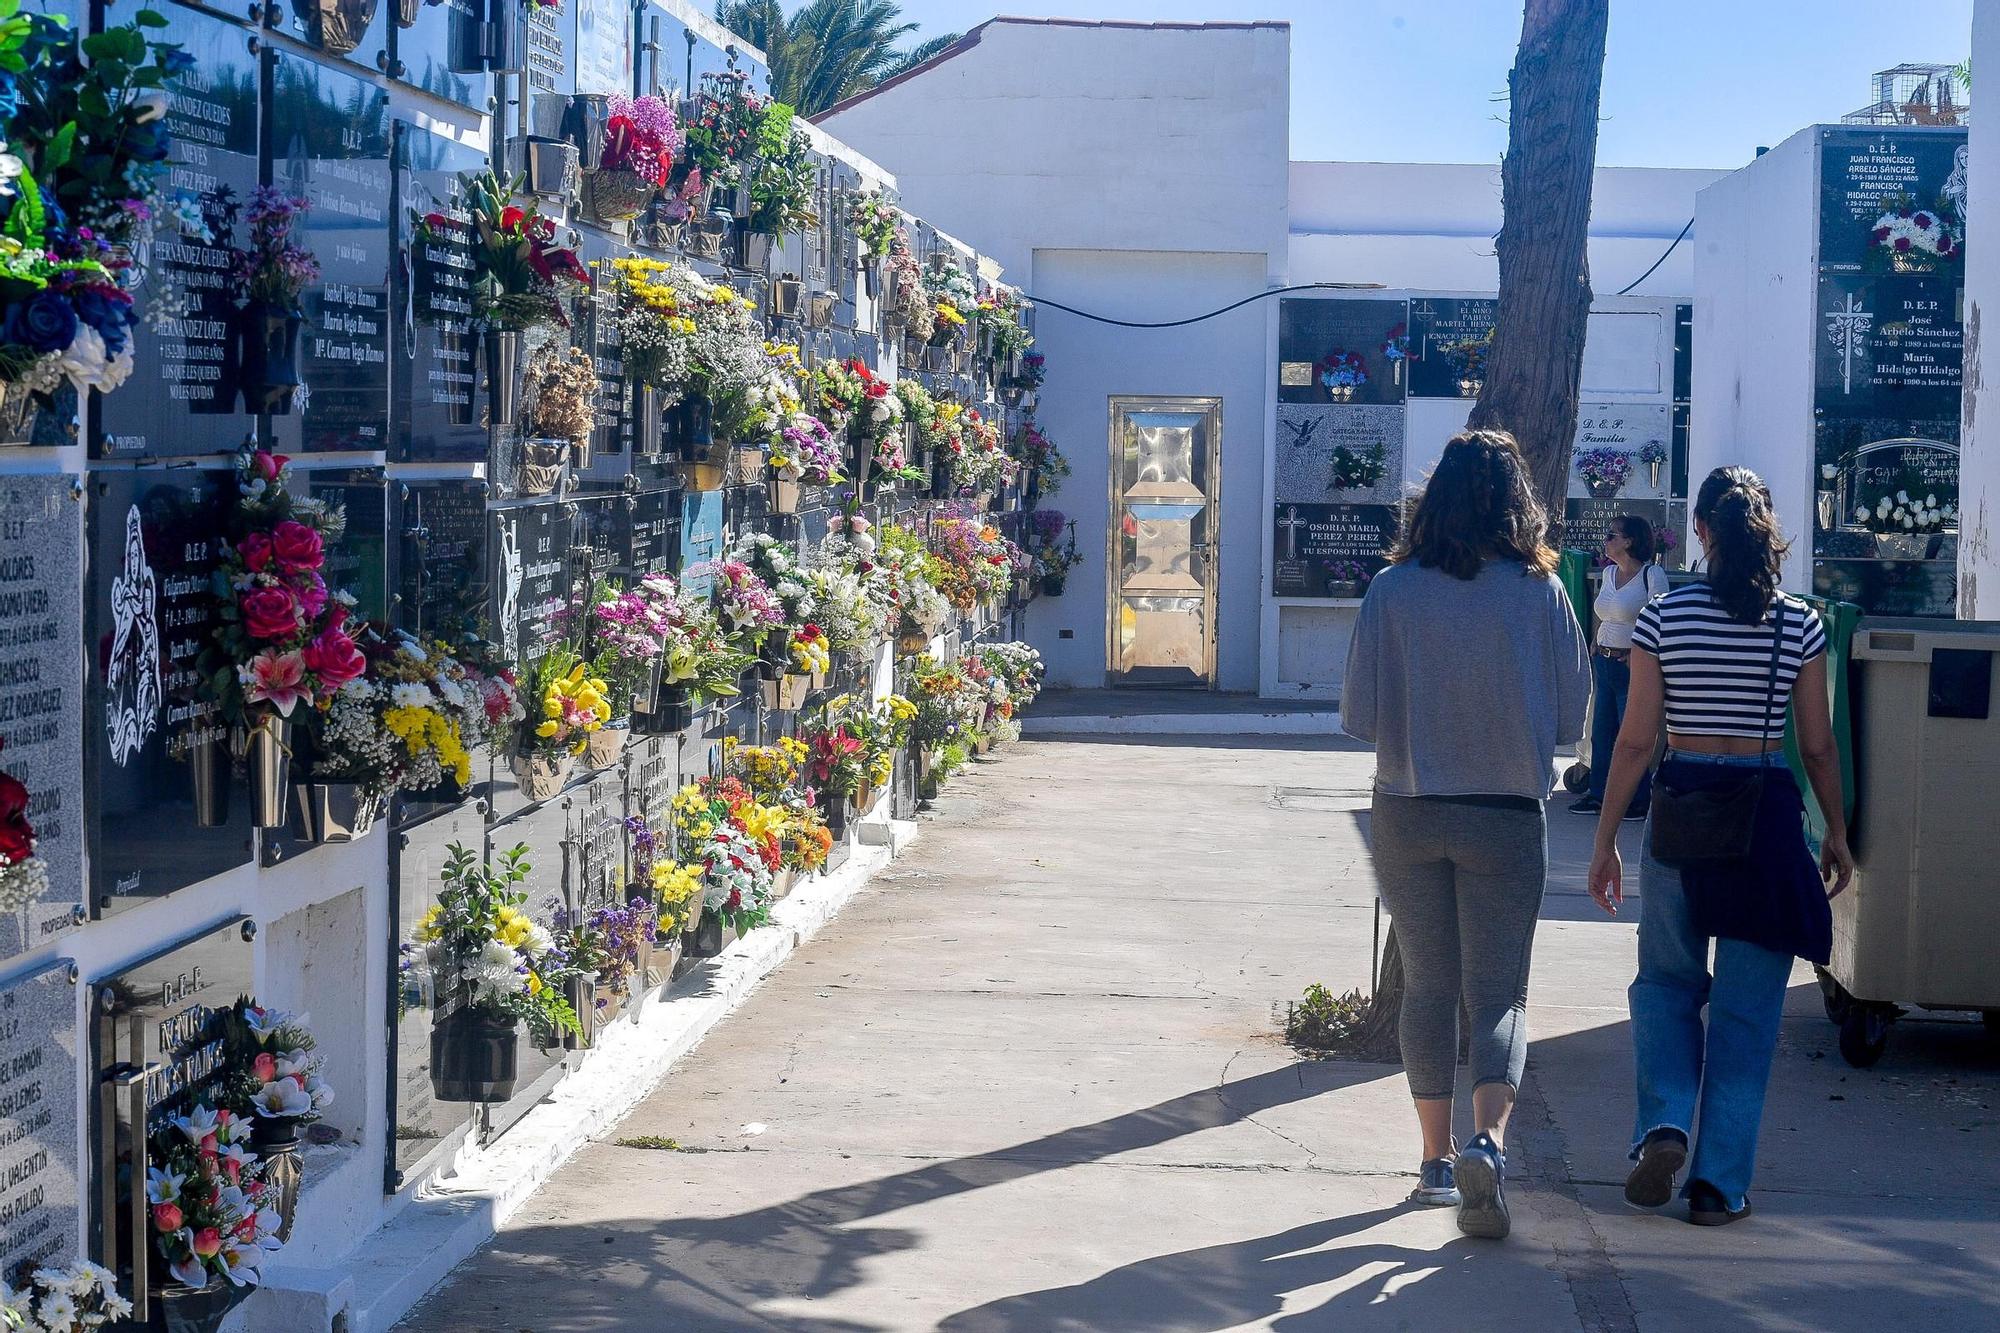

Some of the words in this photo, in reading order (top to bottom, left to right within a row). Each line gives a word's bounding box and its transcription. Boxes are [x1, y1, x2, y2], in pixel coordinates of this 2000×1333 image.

[1850, 155, 1869, 163] JUAN
[1871, 156, 1915, 164] FRANCISCO
[1849, 165, 1879, 173] ARBELO
[1880, 164, 1916, 174] SÁNCHEZ
[1860, 182, 1903, 190] FRANCISCA
[201, 247, 230, 269] GUEDES
[323, 282, 343, 304] Isabel
[343, 285, 358, 309] Vega
[357, 287, 377, 308] Ramos
[343, 312, 357, 337] Vega
[357, 315, 377, 335] Ramos
[1436, 320, 1468, 328] MARTEL
[1908, 315, 1932, 324] José
[1880, 327, 1914, 336] Arbelo
[1917, 327, 1960, 337] Sánchez
[326, 339, 351, 361] Carmen
[351, 342, 365, 365] Vega
[364, 343, 385, 363] Ramos
[1904, 353, 1934, 362] María
[1877, 364, 1917, 375] Hidalgo
[1920, 365, 1961, 376] Hidalgo
[1581, 433, 1628, 443] Familia
[1309, 523, 1346, 531] OSORIA
[1347, 533, 1379, 541] PEREZ
[27, 787, 61, 819] ERDOMO
[15, 1080, 42, 1113] LEMES
[15, 1182, 45, 1219] PULIDO
